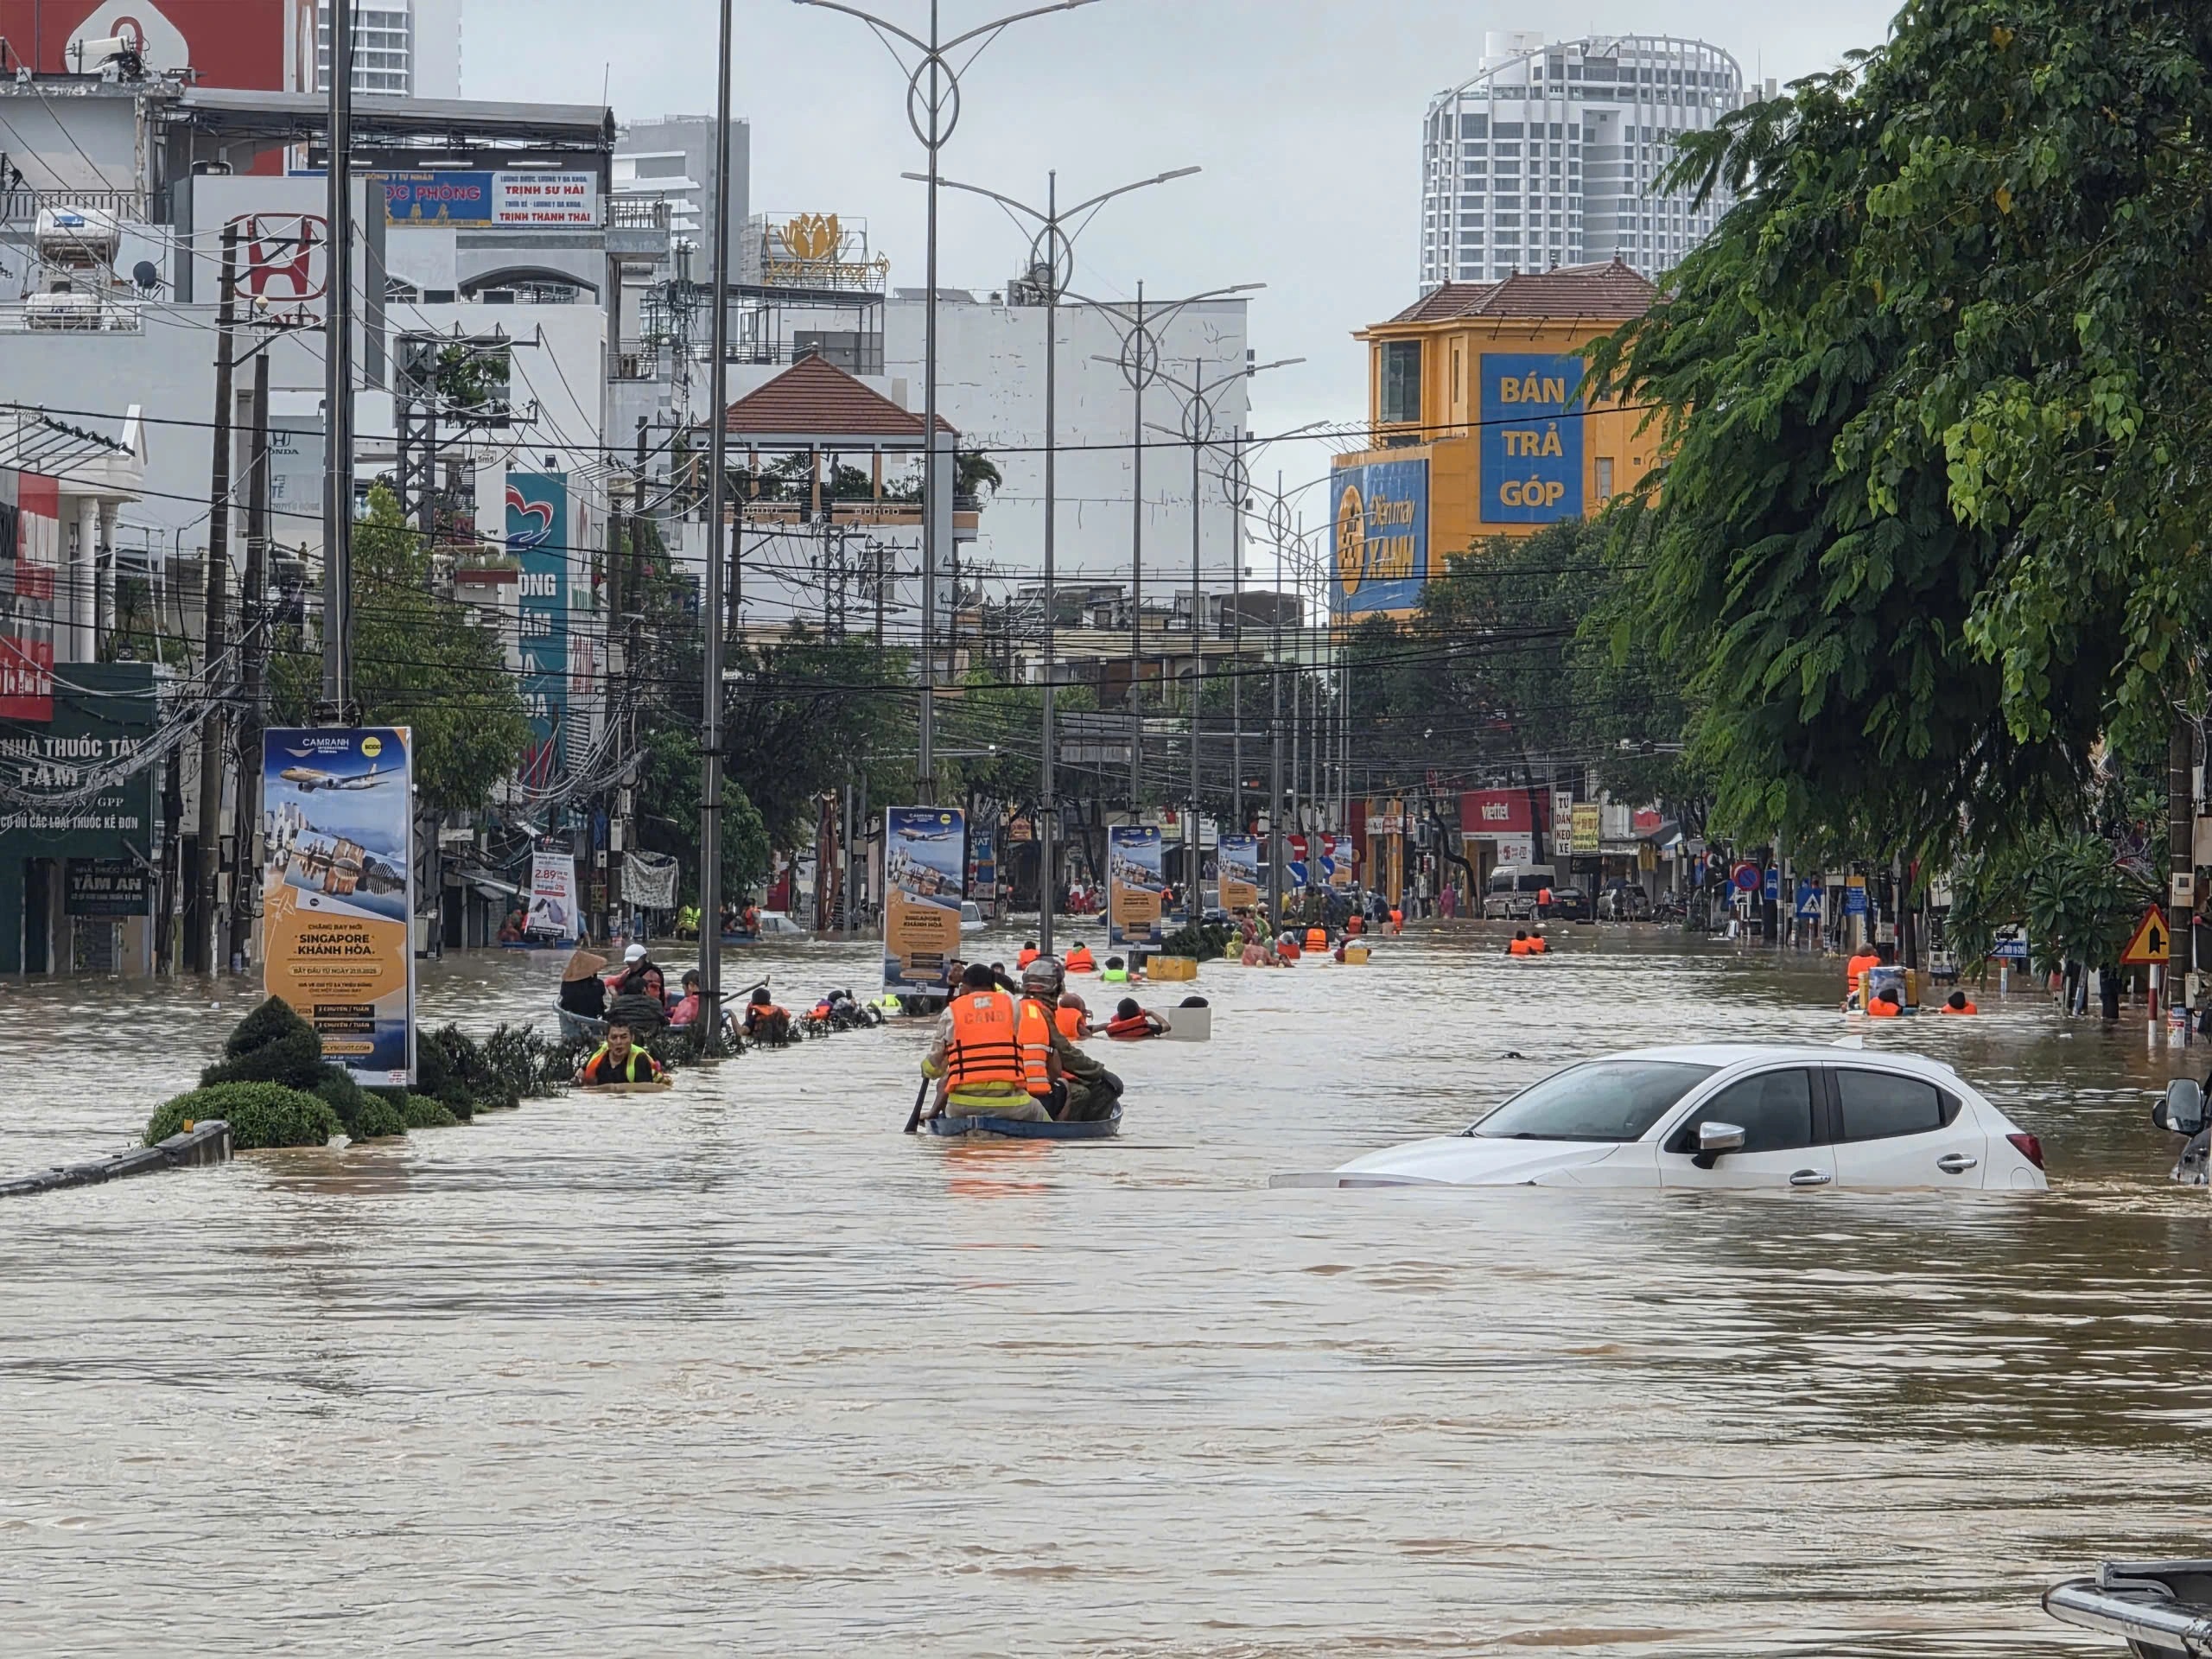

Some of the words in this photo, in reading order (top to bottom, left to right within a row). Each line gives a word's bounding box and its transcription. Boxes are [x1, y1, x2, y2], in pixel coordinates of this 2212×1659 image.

[1500, 371, 1566, 404] BÁN
[1502, 422, 1563, 457] TRẢ
[1499, 474, 1566, 507] GÓP
[1365, 534, 1415, 581] XANH
[518, 568, 556, 597] ÒNG
[520, 608, 551, 637] ÁM
[44, 732, 103, 757] THUỐC
[109, 735, 141, 757] TÂY
[97, 797, 124, 807] GPP
[1556, 811, 1571, 824] DÁN
[1556, 830, 1571, 840] KEO
[1559, 842, 1569, 854] XE
[116, 877, 142, 890] AN
[299, 934, 370, 943] SINGAPORE
[298, 944, 342, 955] KHÁNH
[344, 944, 372, 955] HÒA
